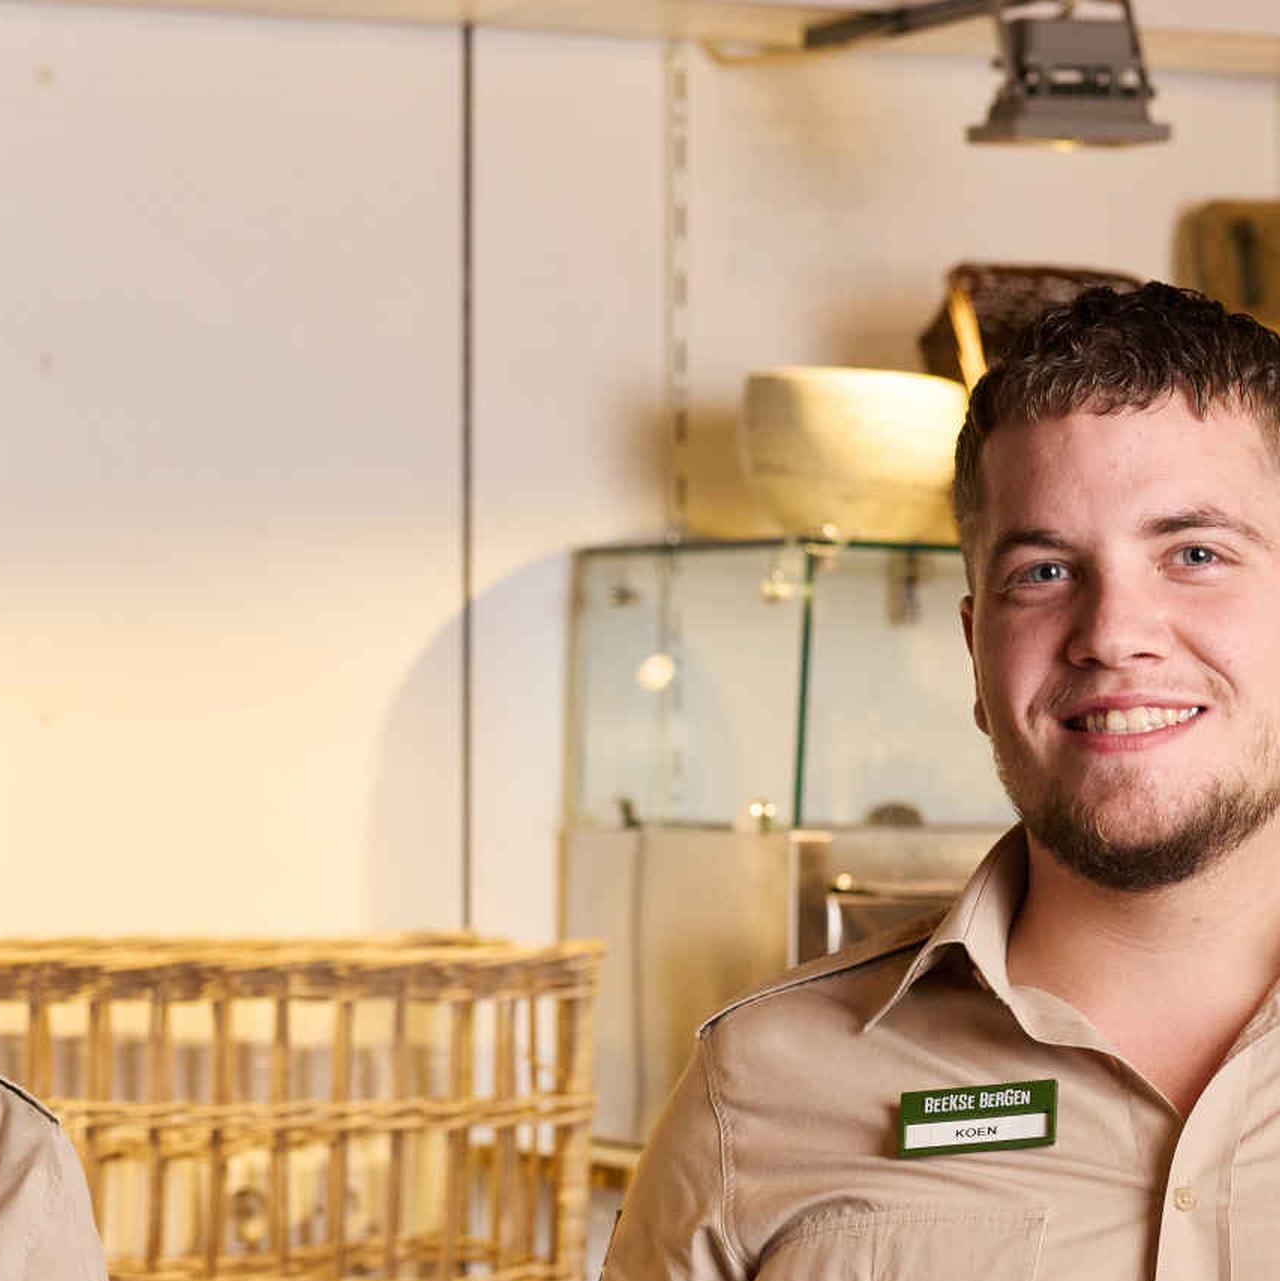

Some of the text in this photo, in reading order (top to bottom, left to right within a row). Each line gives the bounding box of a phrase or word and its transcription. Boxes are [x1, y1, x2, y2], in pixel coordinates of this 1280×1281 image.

[924, 1088, 1031, 1114] BEEKSE BERGEN
[955, 1126, 998, 1139] KOEN
